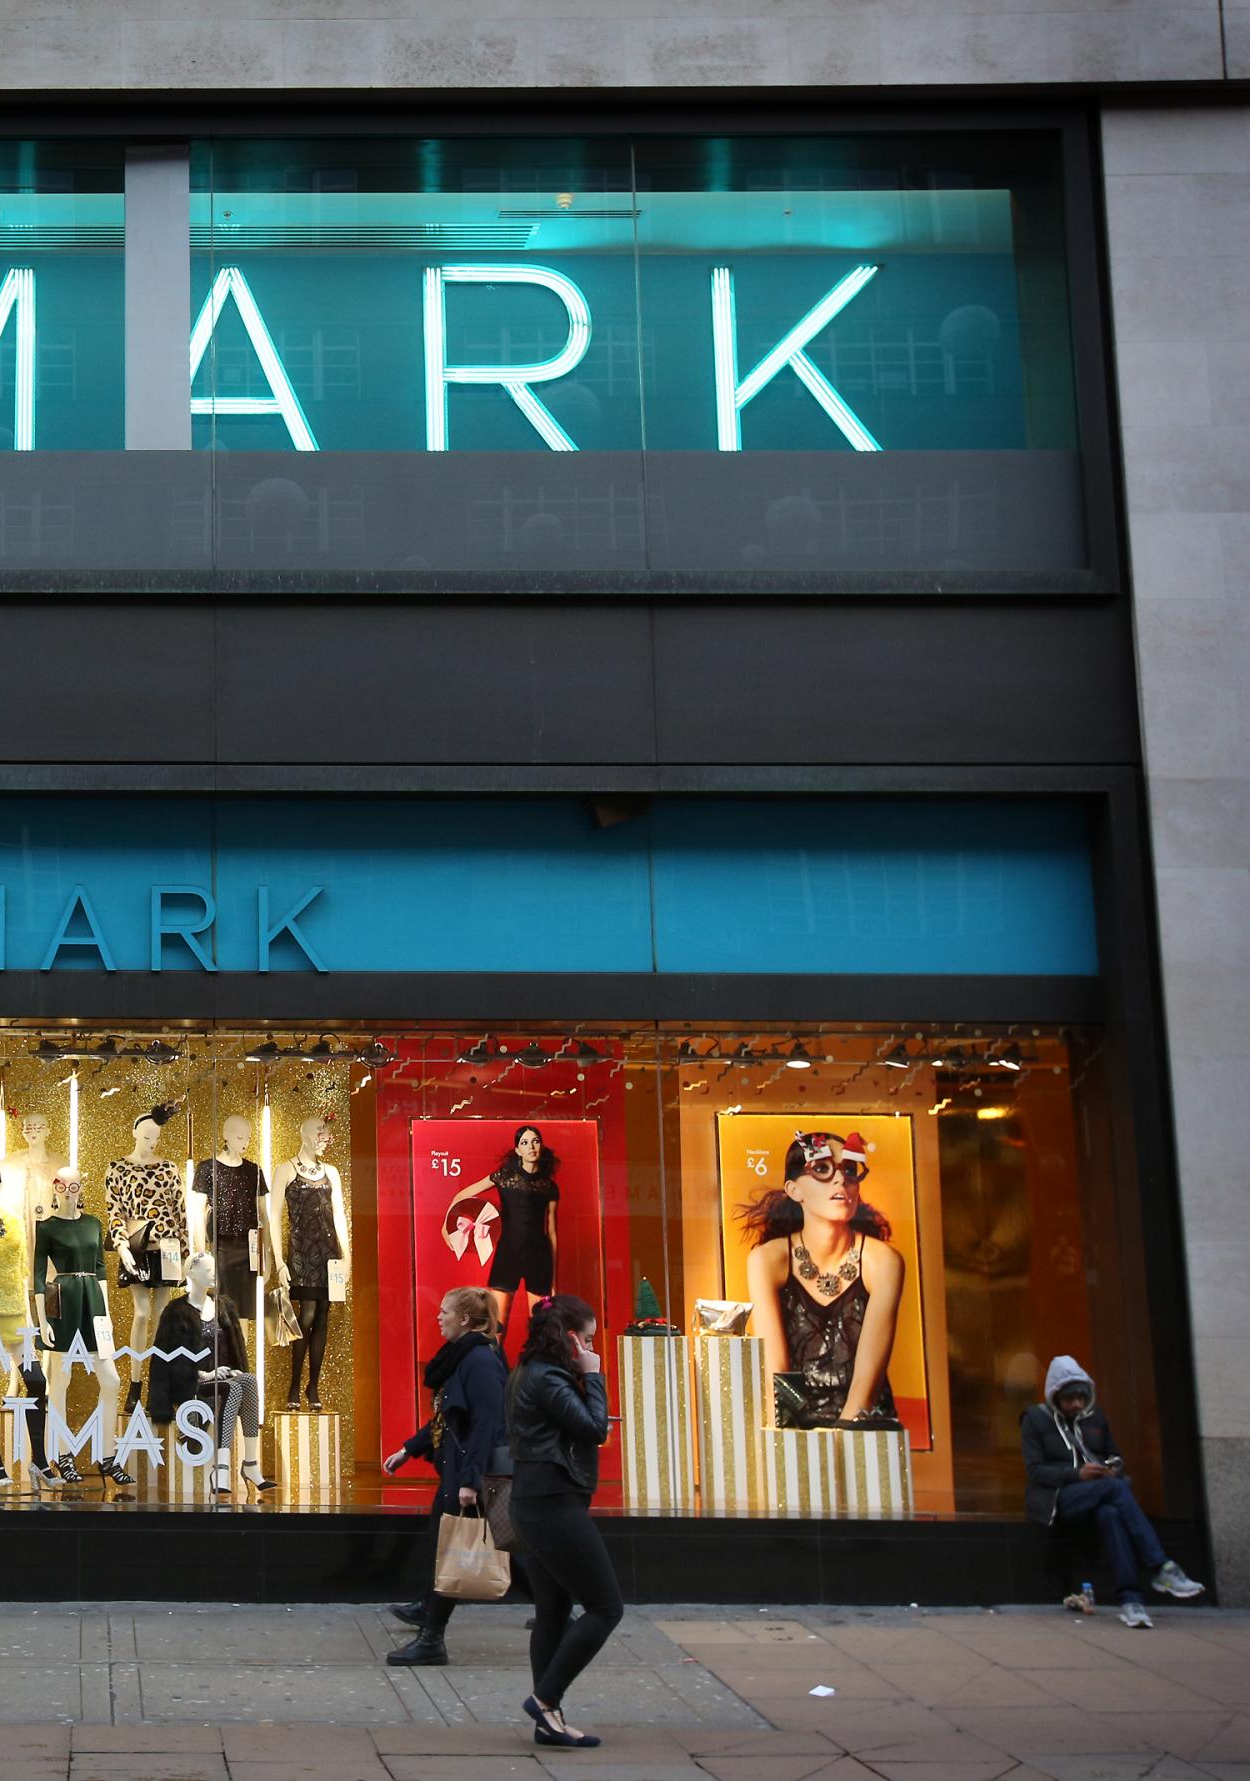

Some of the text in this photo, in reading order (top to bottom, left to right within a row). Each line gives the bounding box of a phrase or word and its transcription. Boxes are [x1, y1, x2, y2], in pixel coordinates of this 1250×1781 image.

[431, 1158, 462, 1177] £15
[746, 1157, 767, 1176] £6
[62, 1328, 96, 1374] A
